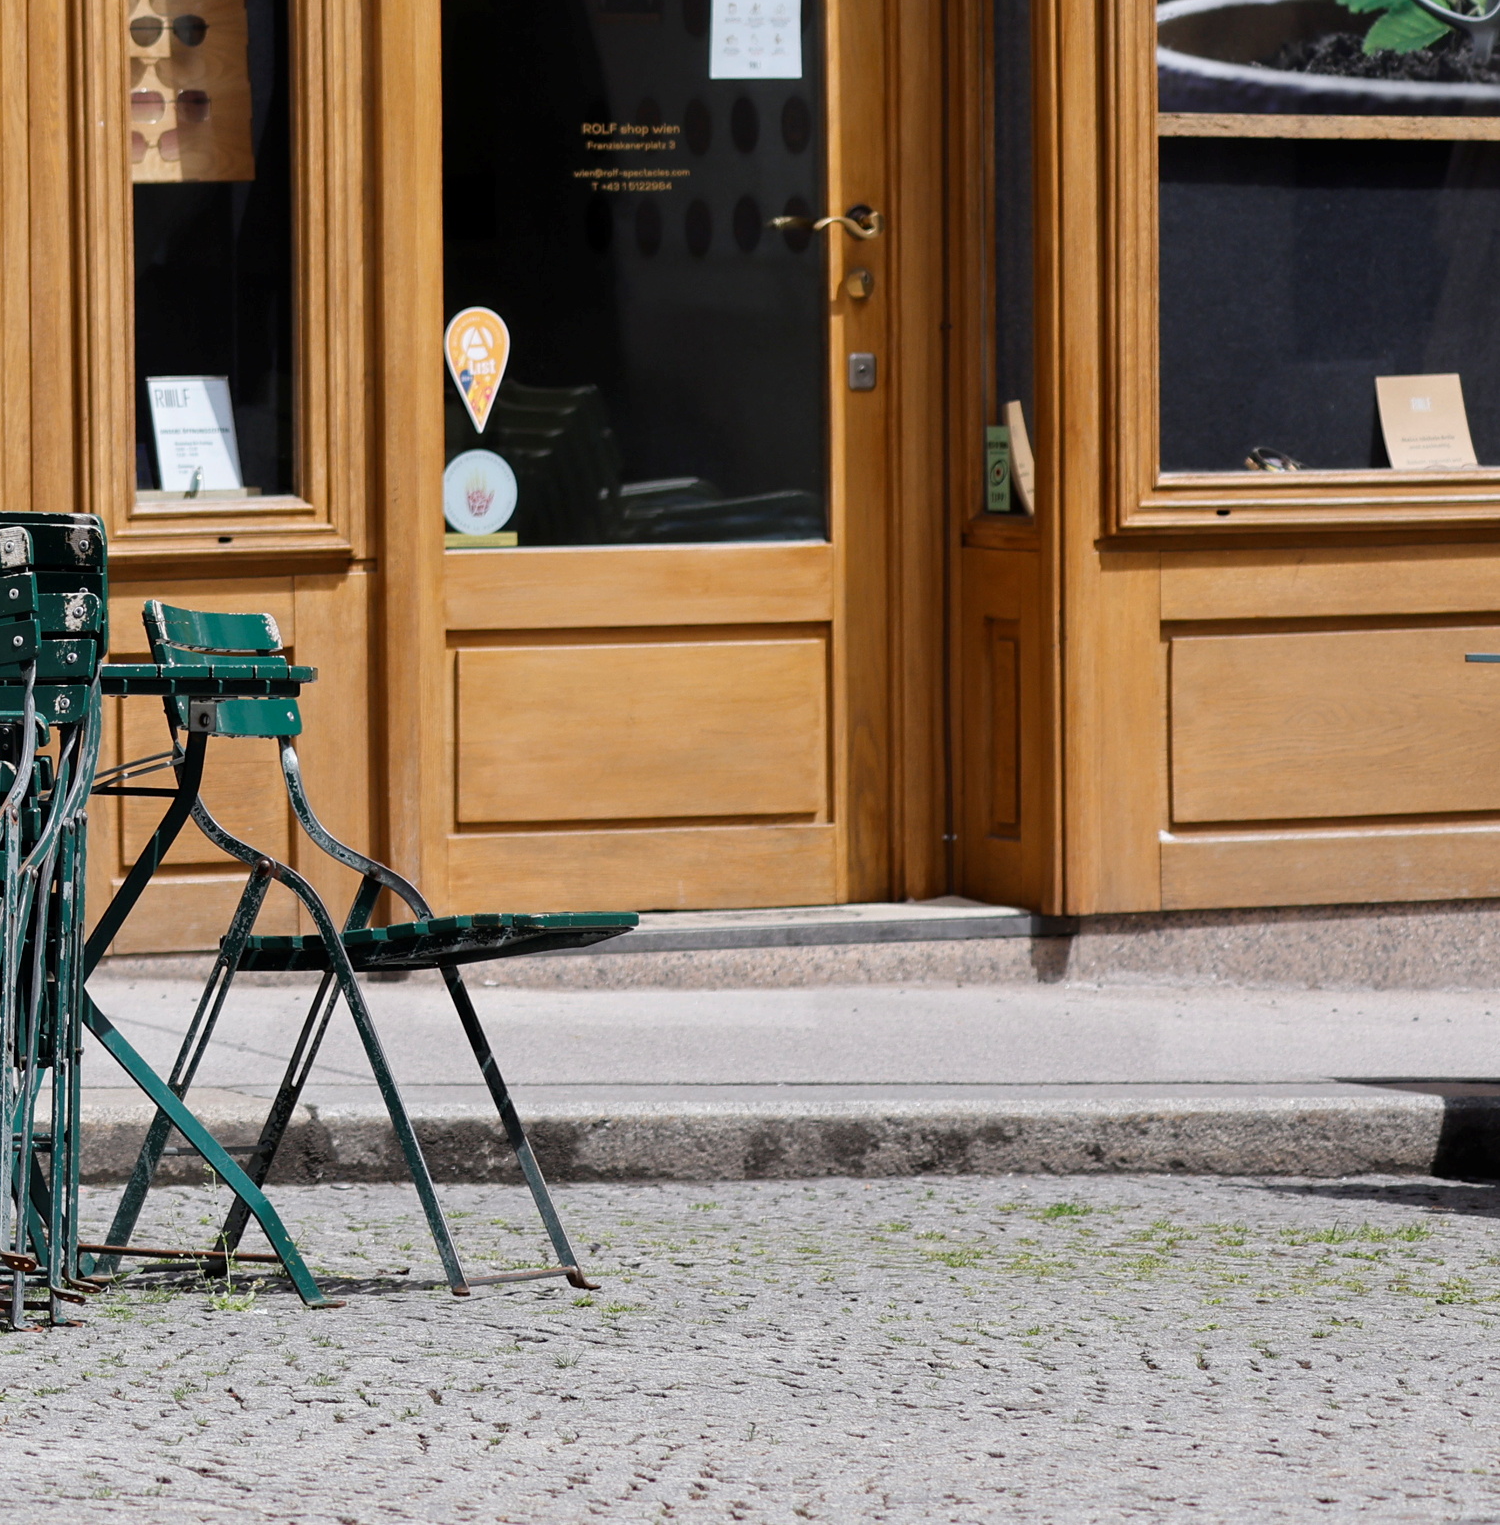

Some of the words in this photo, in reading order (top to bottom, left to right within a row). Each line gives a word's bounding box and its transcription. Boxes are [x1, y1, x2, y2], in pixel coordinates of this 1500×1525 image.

[582, 122, 618, 135] ROLF
[620, 123, 650, 137] shop
[652, 123, 681, 135] wien
